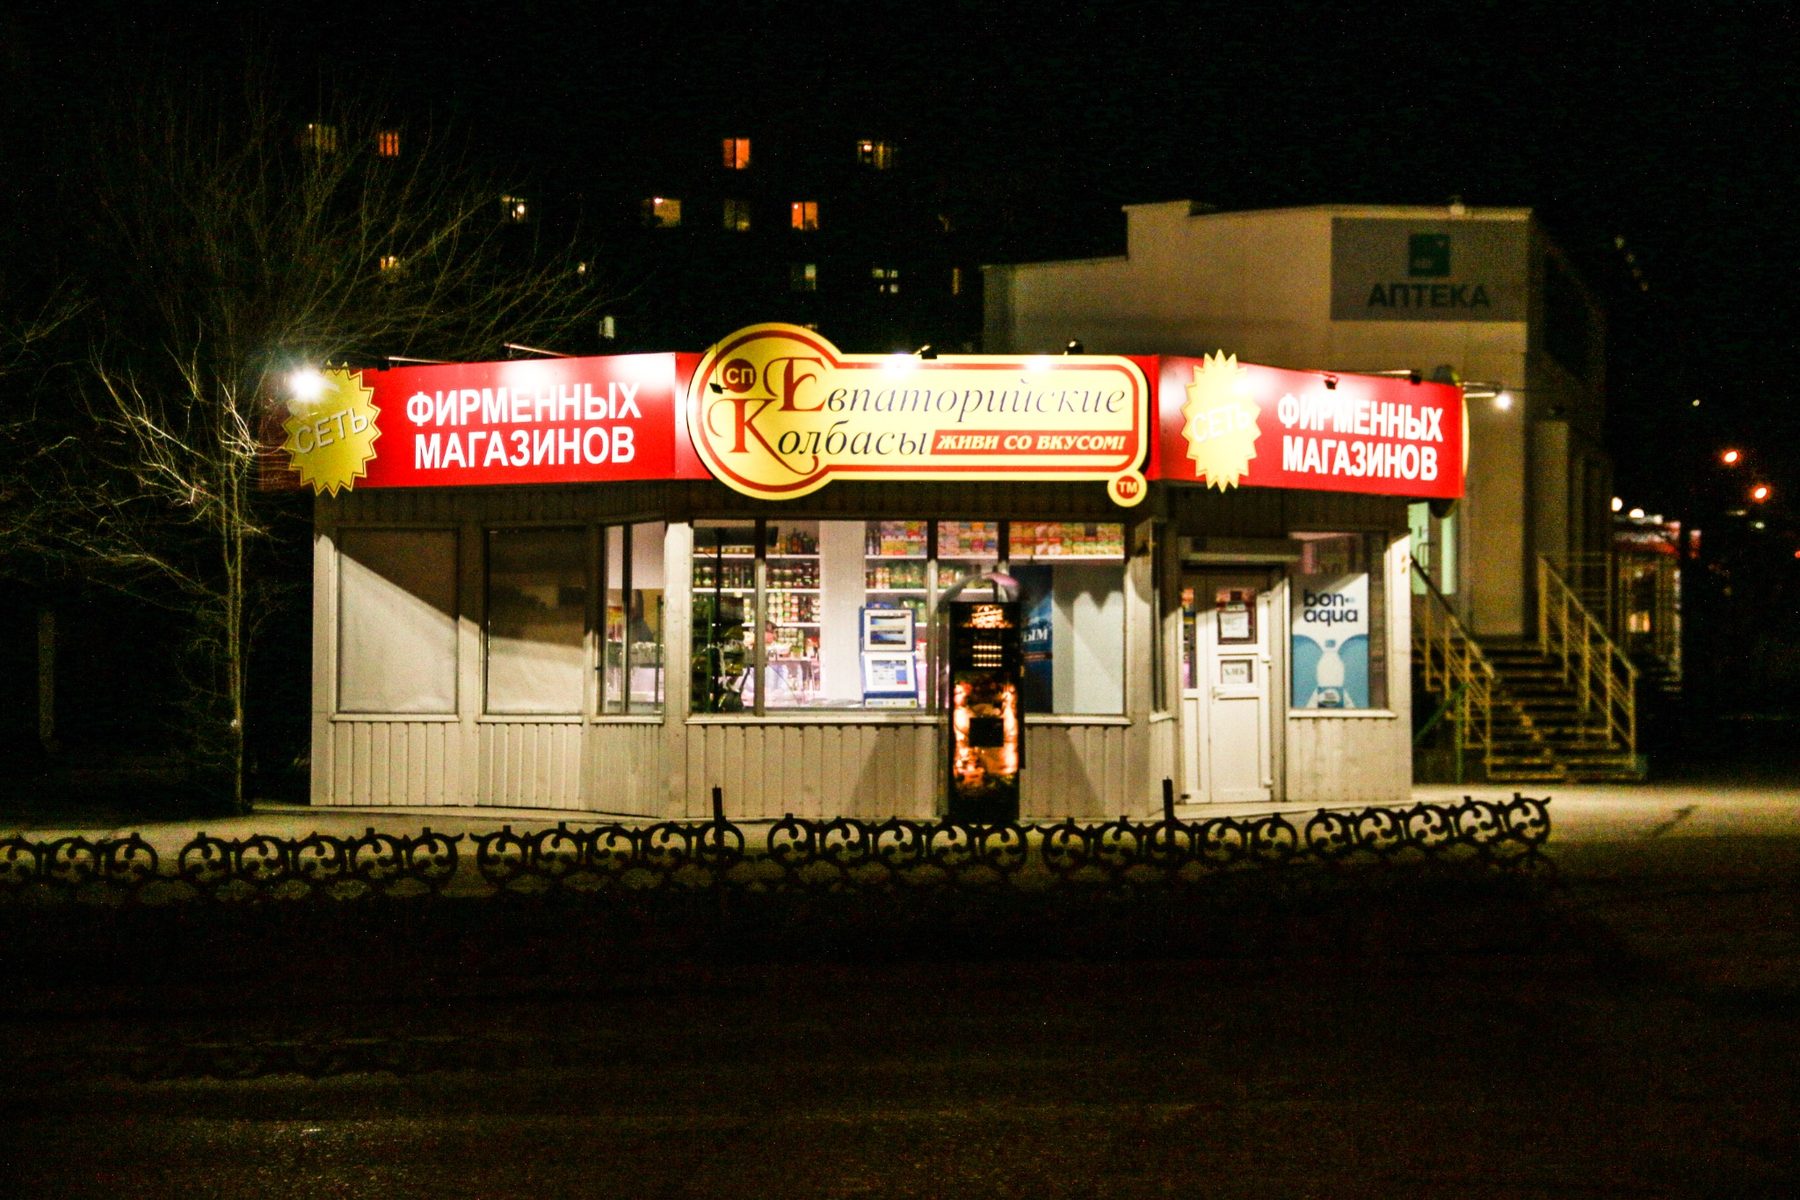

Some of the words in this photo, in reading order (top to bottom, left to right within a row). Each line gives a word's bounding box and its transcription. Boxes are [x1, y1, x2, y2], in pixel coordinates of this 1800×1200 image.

[1367, 283, 1490, 307] АПТЕКА
[726, 366, 754, 387] СП
[764, 356, 1126, 423] Евпаторийские
[406, 381, 643, 427] ФИРМЕННЫХ
[1191, 402, 1252, 443] СЕТЬ
[1277, 393, 1444, 442] ФИРМЕННЫХ
[295, 408, 369, 454] СЕТЬ
[414, 426, 636, 471] МАГАЗИНОВ
[707, 398, 928, 474] Колбасы
[936, 435, 998, 451] ЖИВИ
[1003, 435, 1033, 451] СО
[1036, 434, 1126, 452] ВКУСОМ!
[1282, 435, 1438, 481] МАГАЗИНОВ
[1303, 589, 1344, 607] bon
[1303, 608, 1358, 627] aqua
